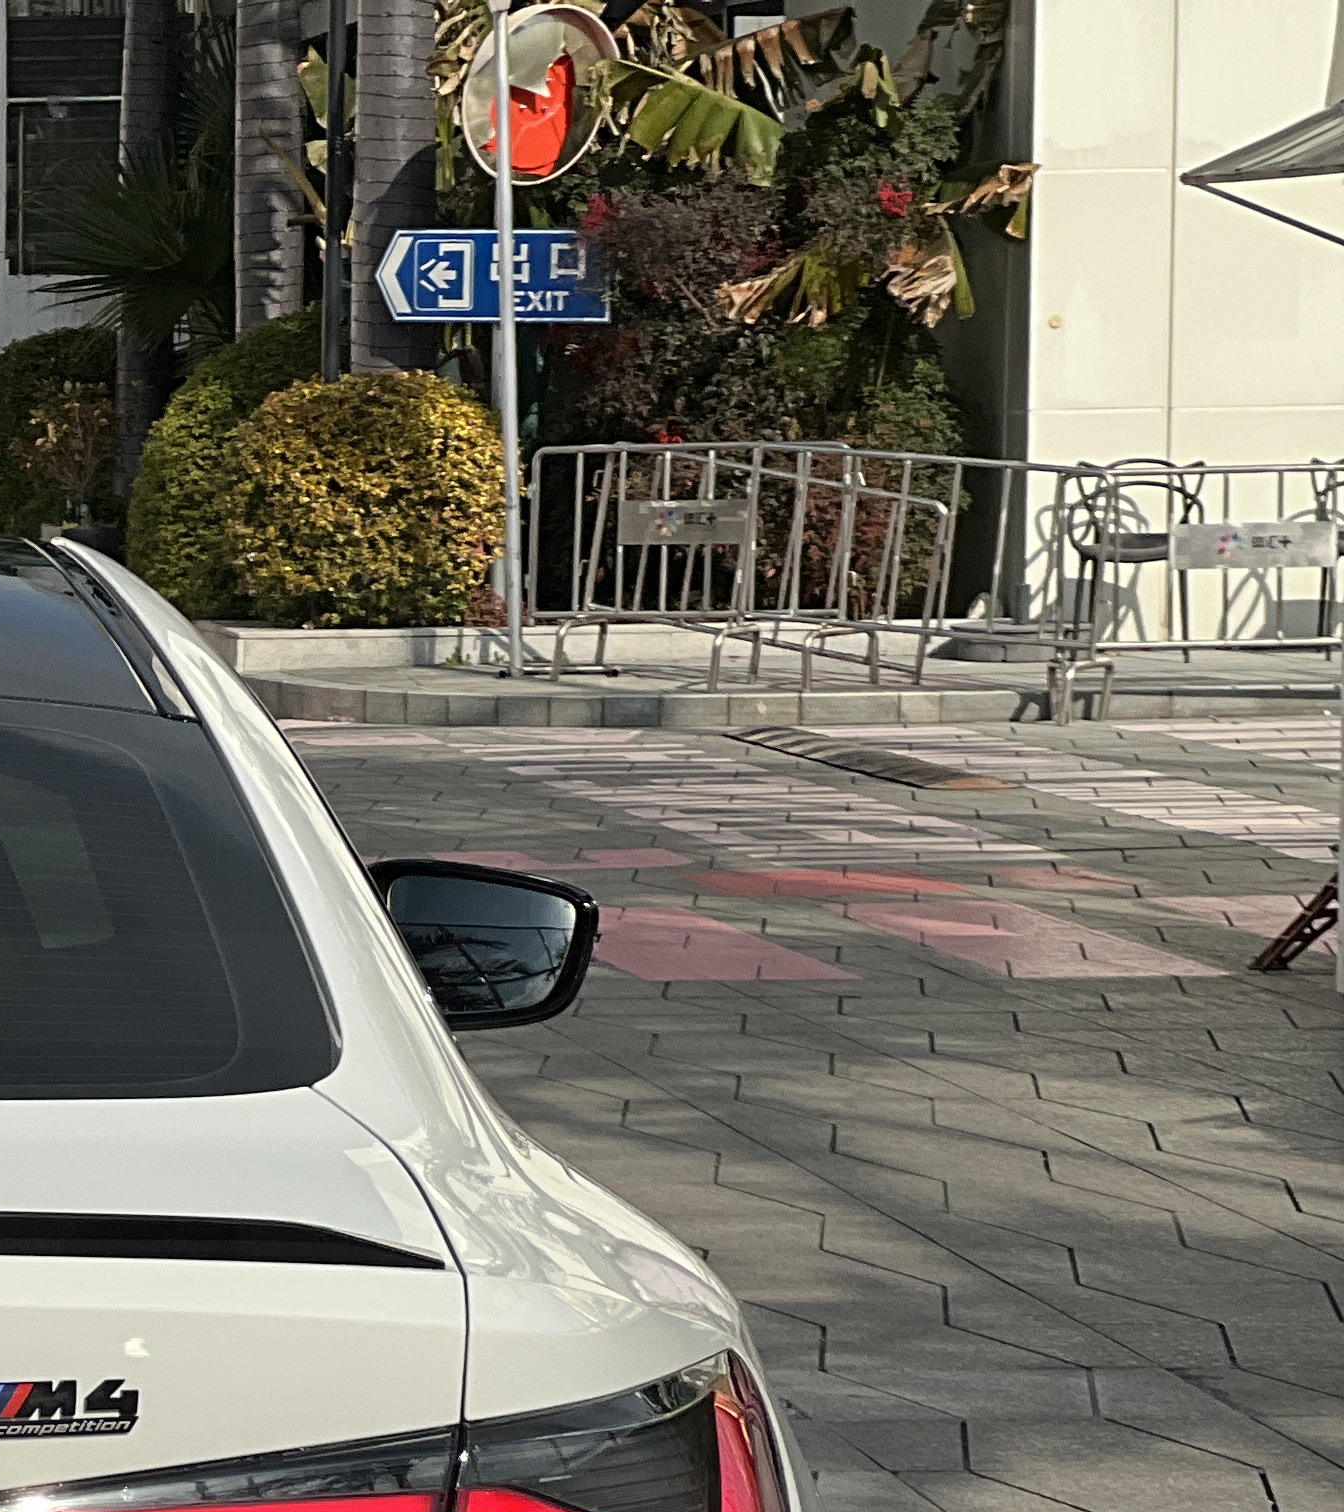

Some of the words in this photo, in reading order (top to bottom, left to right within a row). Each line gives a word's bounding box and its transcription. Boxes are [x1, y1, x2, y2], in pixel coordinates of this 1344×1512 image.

[490, 239, 587, 284] 出口
[513, 290, 571, 312] EXIT
[14, 1379, 139, 1419] M4
